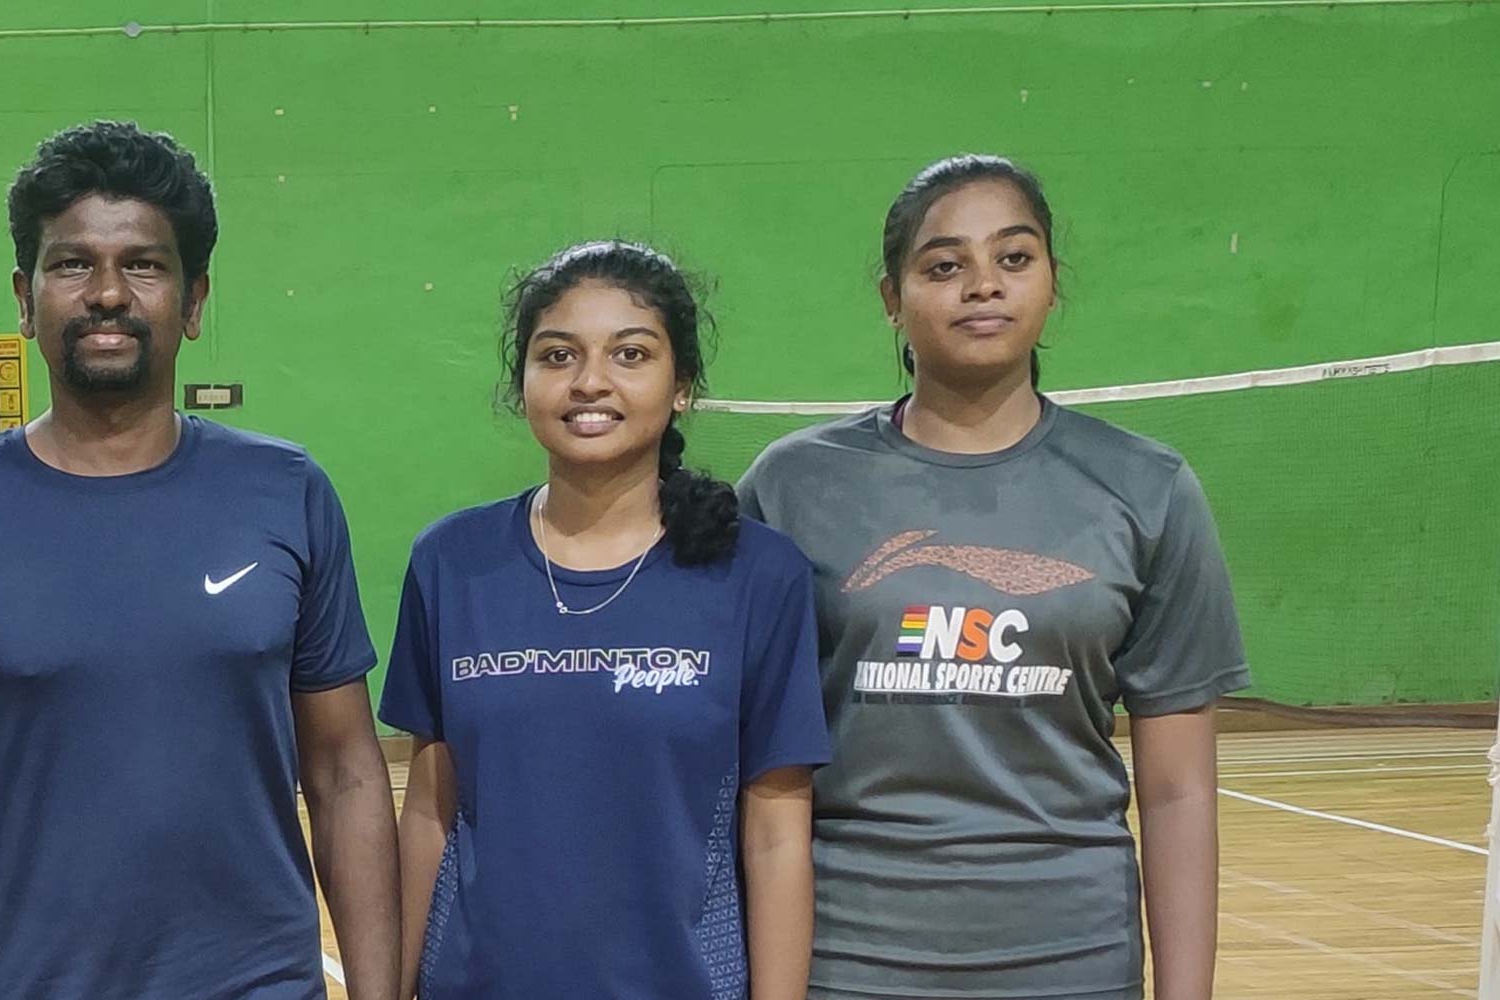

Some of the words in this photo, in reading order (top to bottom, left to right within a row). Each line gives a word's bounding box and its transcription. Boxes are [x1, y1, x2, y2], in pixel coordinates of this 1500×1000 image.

[920, 606, 1029, 663] NSC
[452, 647, 710, 681] BAD'MINTON
[935, 663, 1002, 692] SPORTS
[1006, 665, 1073, 695] CENTRE
